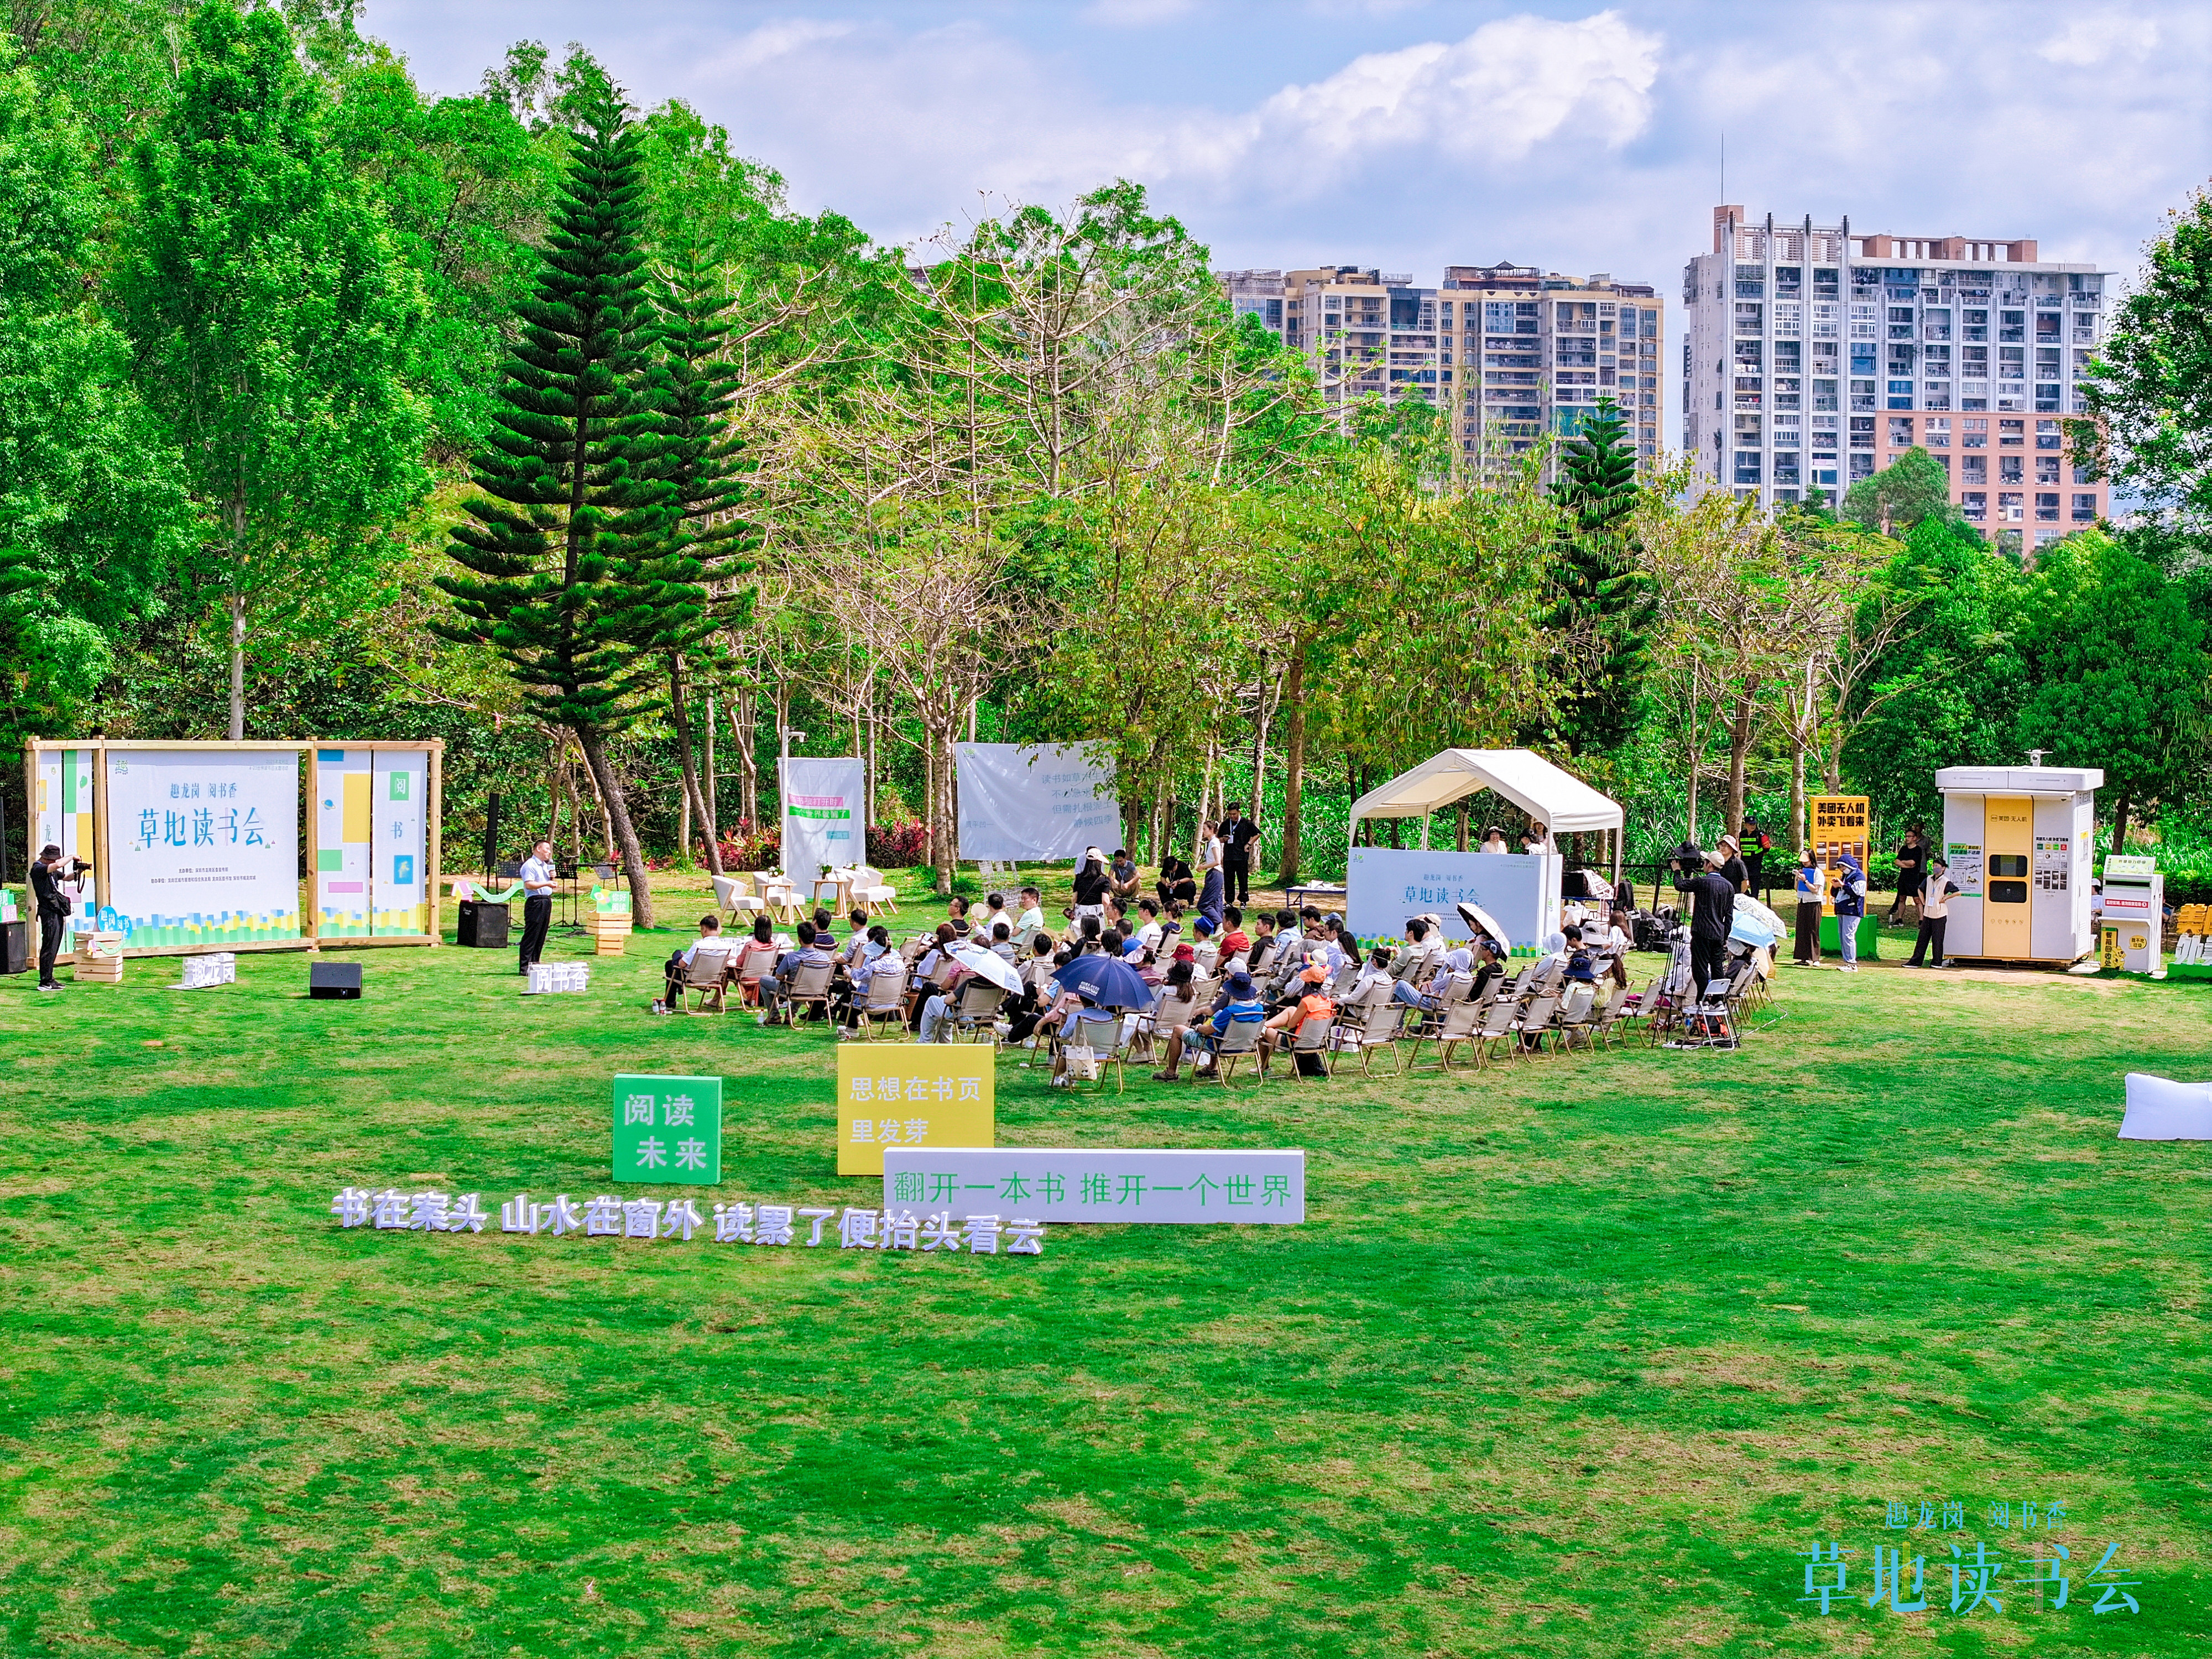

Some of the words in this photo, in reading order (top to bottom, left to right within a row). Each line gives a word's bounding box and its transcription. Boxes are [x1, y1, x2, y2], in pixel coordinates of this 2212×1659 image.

[170, 782, 199, 799] 趣龙岗
[208, 782, 237, 799] 阅书香
[1052, 801, 1113, 814] 但需扎根泥土
[1818, 802, 1864, 813] 美团无人机
[138, 807, 265, 848] 草地读书会
[1818, 816, 1864, 827] 外卖飞着来
[612, 893, 627, 901] 你好
[612, 903, 627, 911] 阅读
[1404, 886, 1480, 905] 草地读书会
[2176, 903, 2212, 935] 美
[850, 1076, 981, 1101] 思想在书页
[624, 1094, 695, 1126] 阅读
[850, 1119, 929, 1144] 里发芽
[637, 1136, 707, 1171] 未来
[893, 1171, 1066, 1206] 翻开一本书
[1080, 1172, 1292, 1206] 推开一个世界
[331, 1187, 488, 1233] 书在案头
[502, 1194, 705, 1241] 山水在窗外
[713, 1200, 1046, 1255] 读累了便抬头看云
